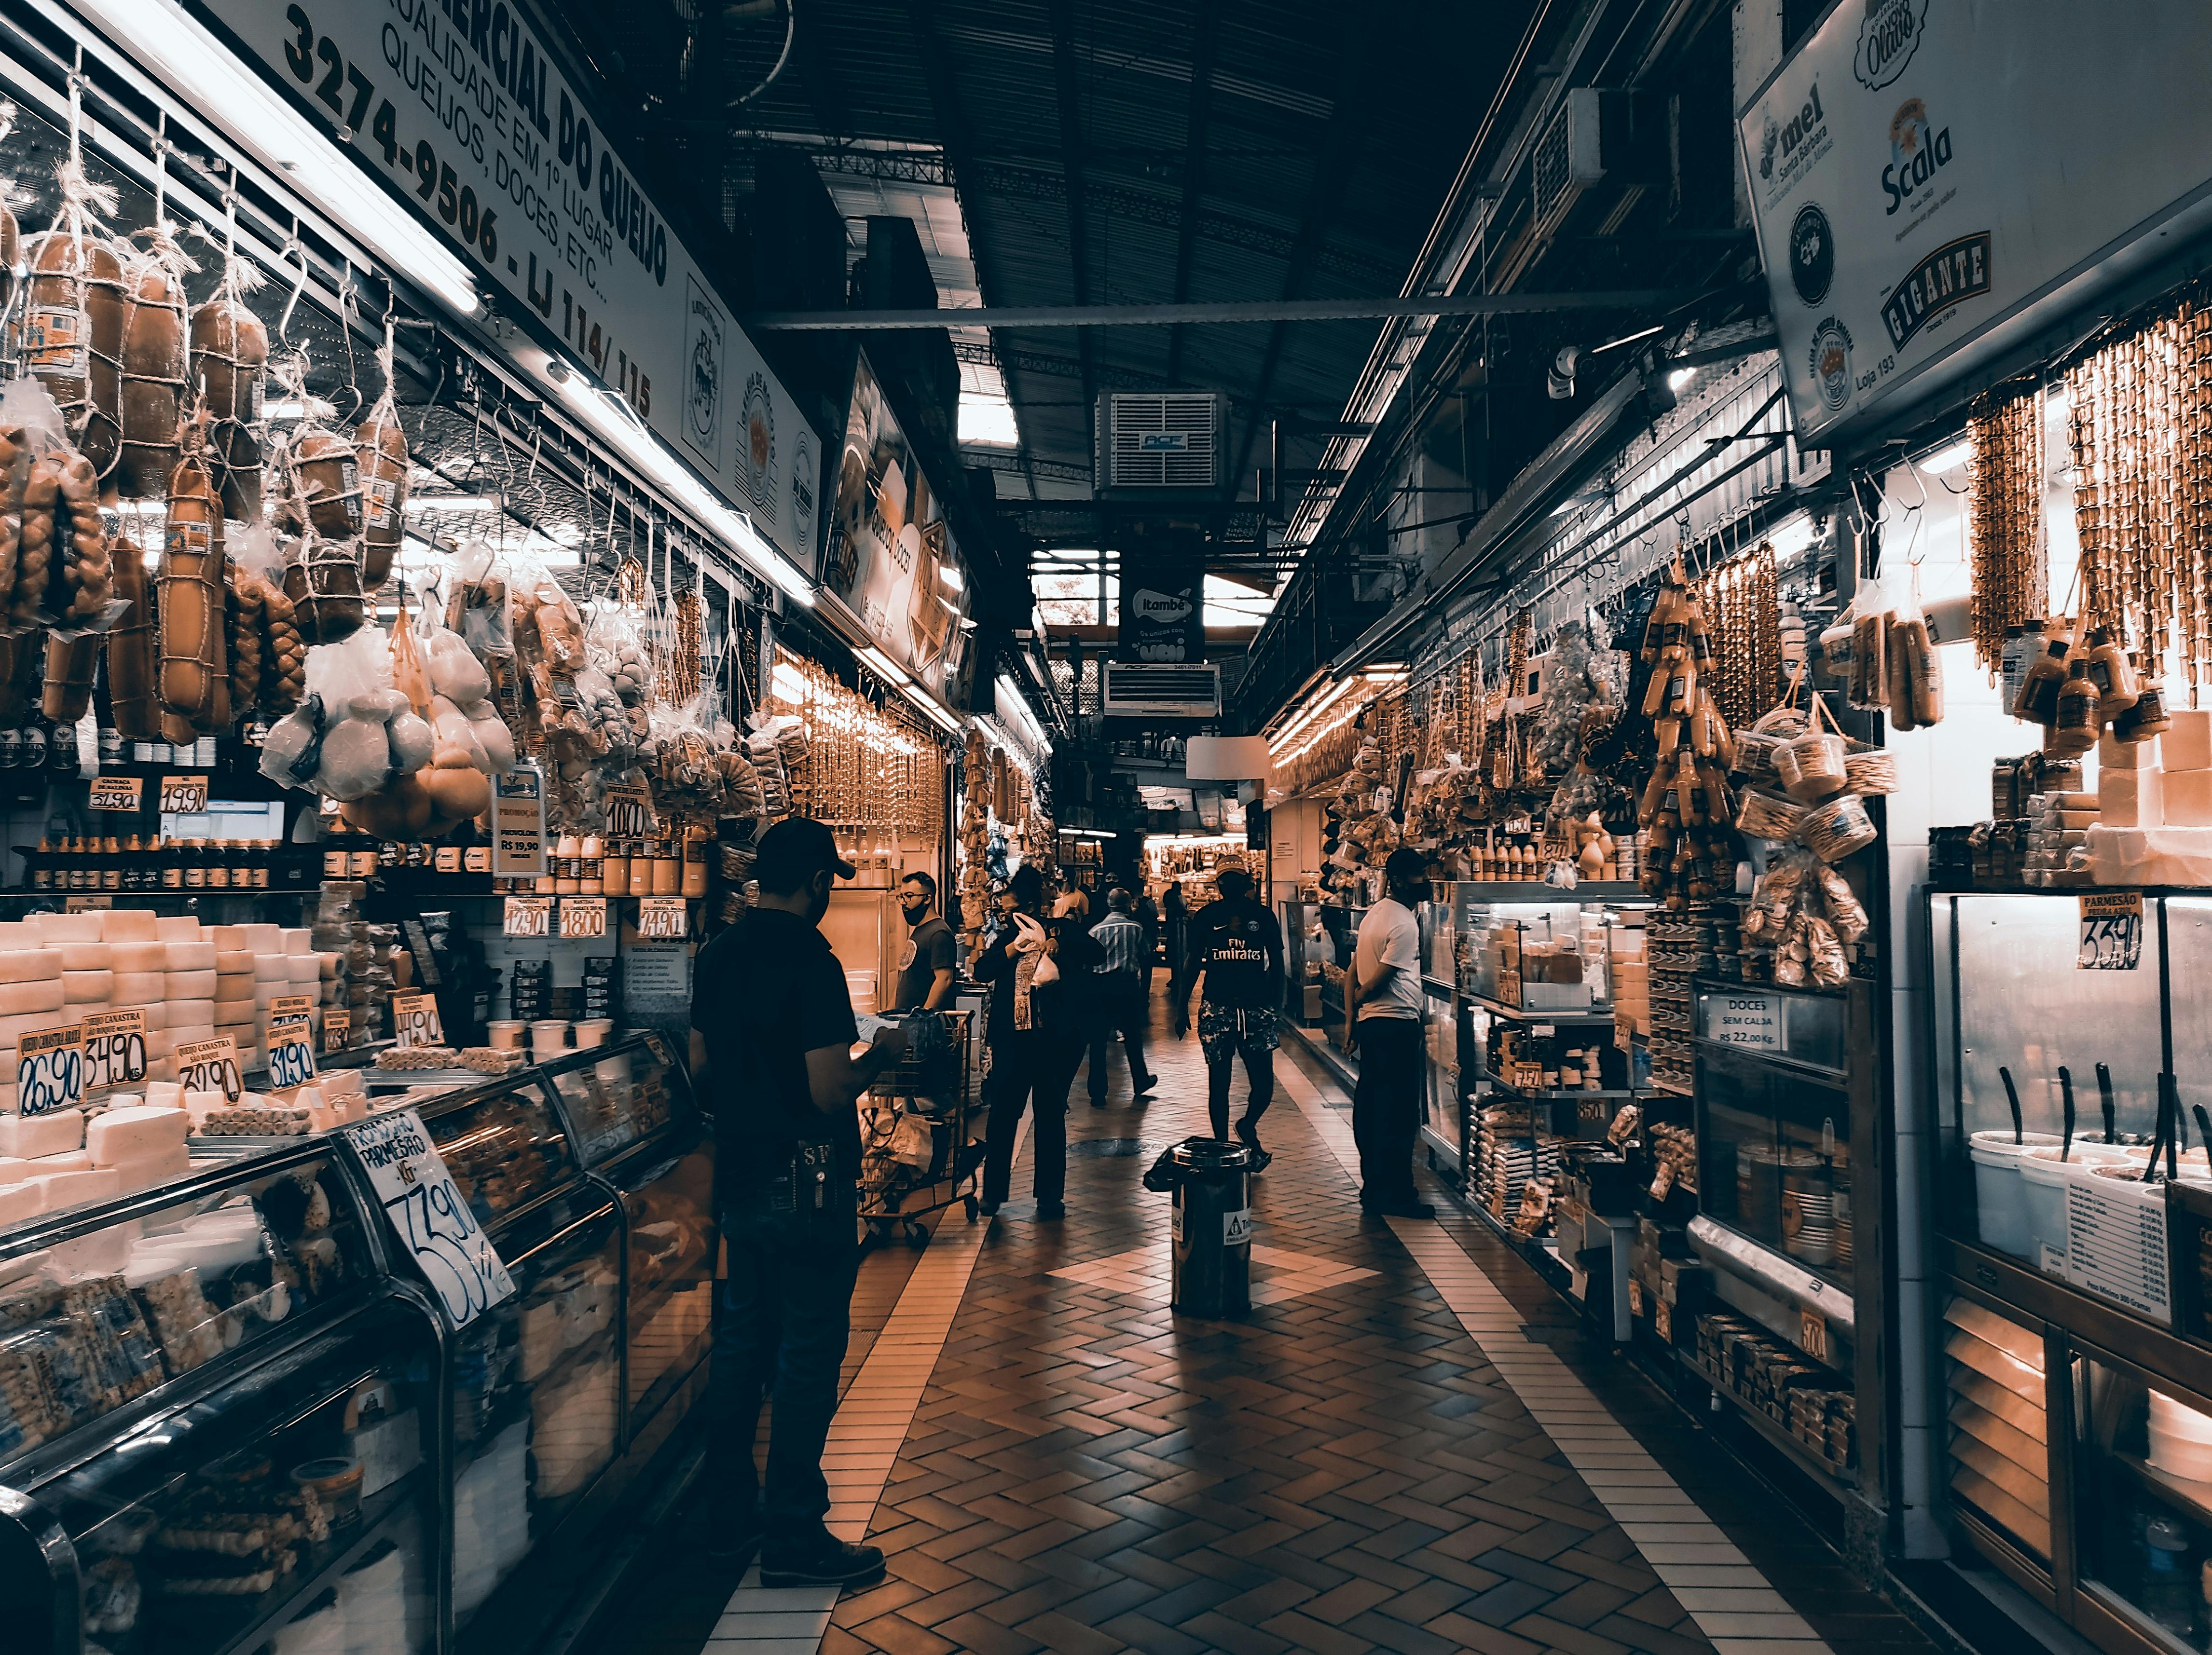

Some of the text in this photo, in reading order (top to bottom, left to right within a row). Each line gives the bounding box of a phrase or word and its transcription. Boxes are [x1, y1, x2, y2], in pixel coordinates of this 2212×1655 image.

[1780, 82, 1823, 158] mel
[390, 0, 508, 139] UALIDADE
[513, 116, 539, 177] EM
[564, 173, 613, 266] LUGAR
[382, 22, 488, 178] QUEIJOS,
[496, 150, 562, 259] DOCES,
[284, 4, 497, 264] 3274-9506
[527, 251, 553, 319] LJ
[1882, 126, 1953, 216] Scala
[558, 87, 593, 192] DO
[599, 150, 667, 287] QUEIJO
[1888, 245, 1984, 342] GIGANTE
[1855, 355, 1896, 391] Loja 193
[1145, 435, 1182, 444] ACF
[499, 808, 539, 818] PROMOÇÃO
[501, 840, 539, 851] R$ 19,90
[1228, 938, 1246, 949] Fly
[1212, 947, 1261, 960] Emirates
[1729, 999, 1767, 1011] DOCES
[104, 1012, 140, 1024] CANASTRA
[1722, 1016, 1742, 1025] SEM
[1720, 1034, 1731, 1042] R$
[1733, 1032, 1761, 1043] 22,00
[197, 1040, 231, 1052] CANASTRA
[359, 1135, 426, 1168] PARMESÃO
